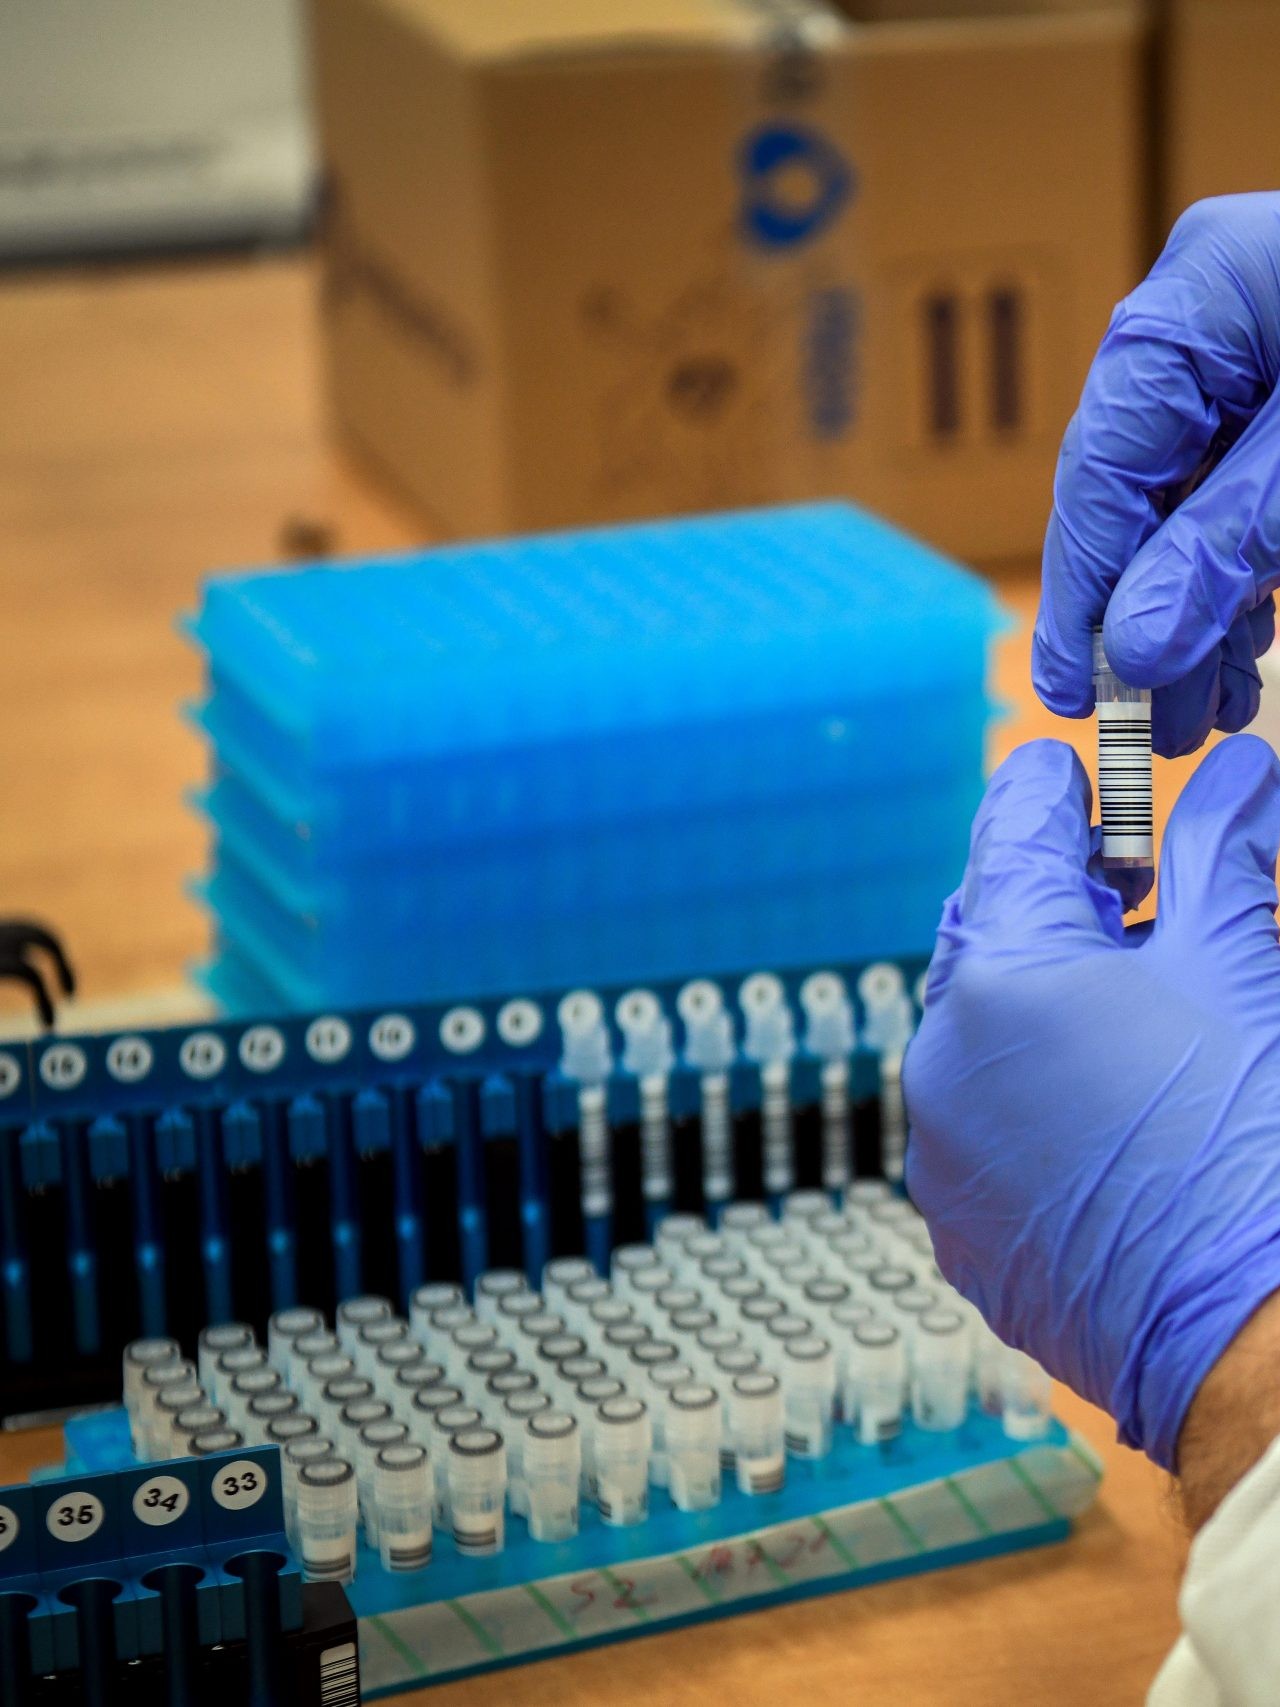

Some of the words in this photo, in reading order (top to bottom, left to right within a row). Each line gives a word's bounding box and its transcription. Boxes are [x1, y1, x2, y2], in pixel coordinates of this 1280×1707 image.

[223, 1472, 258, 1496] 33
[143, 1488, 179, 1512] 34
[57, 1505, 94, 1526] 35
